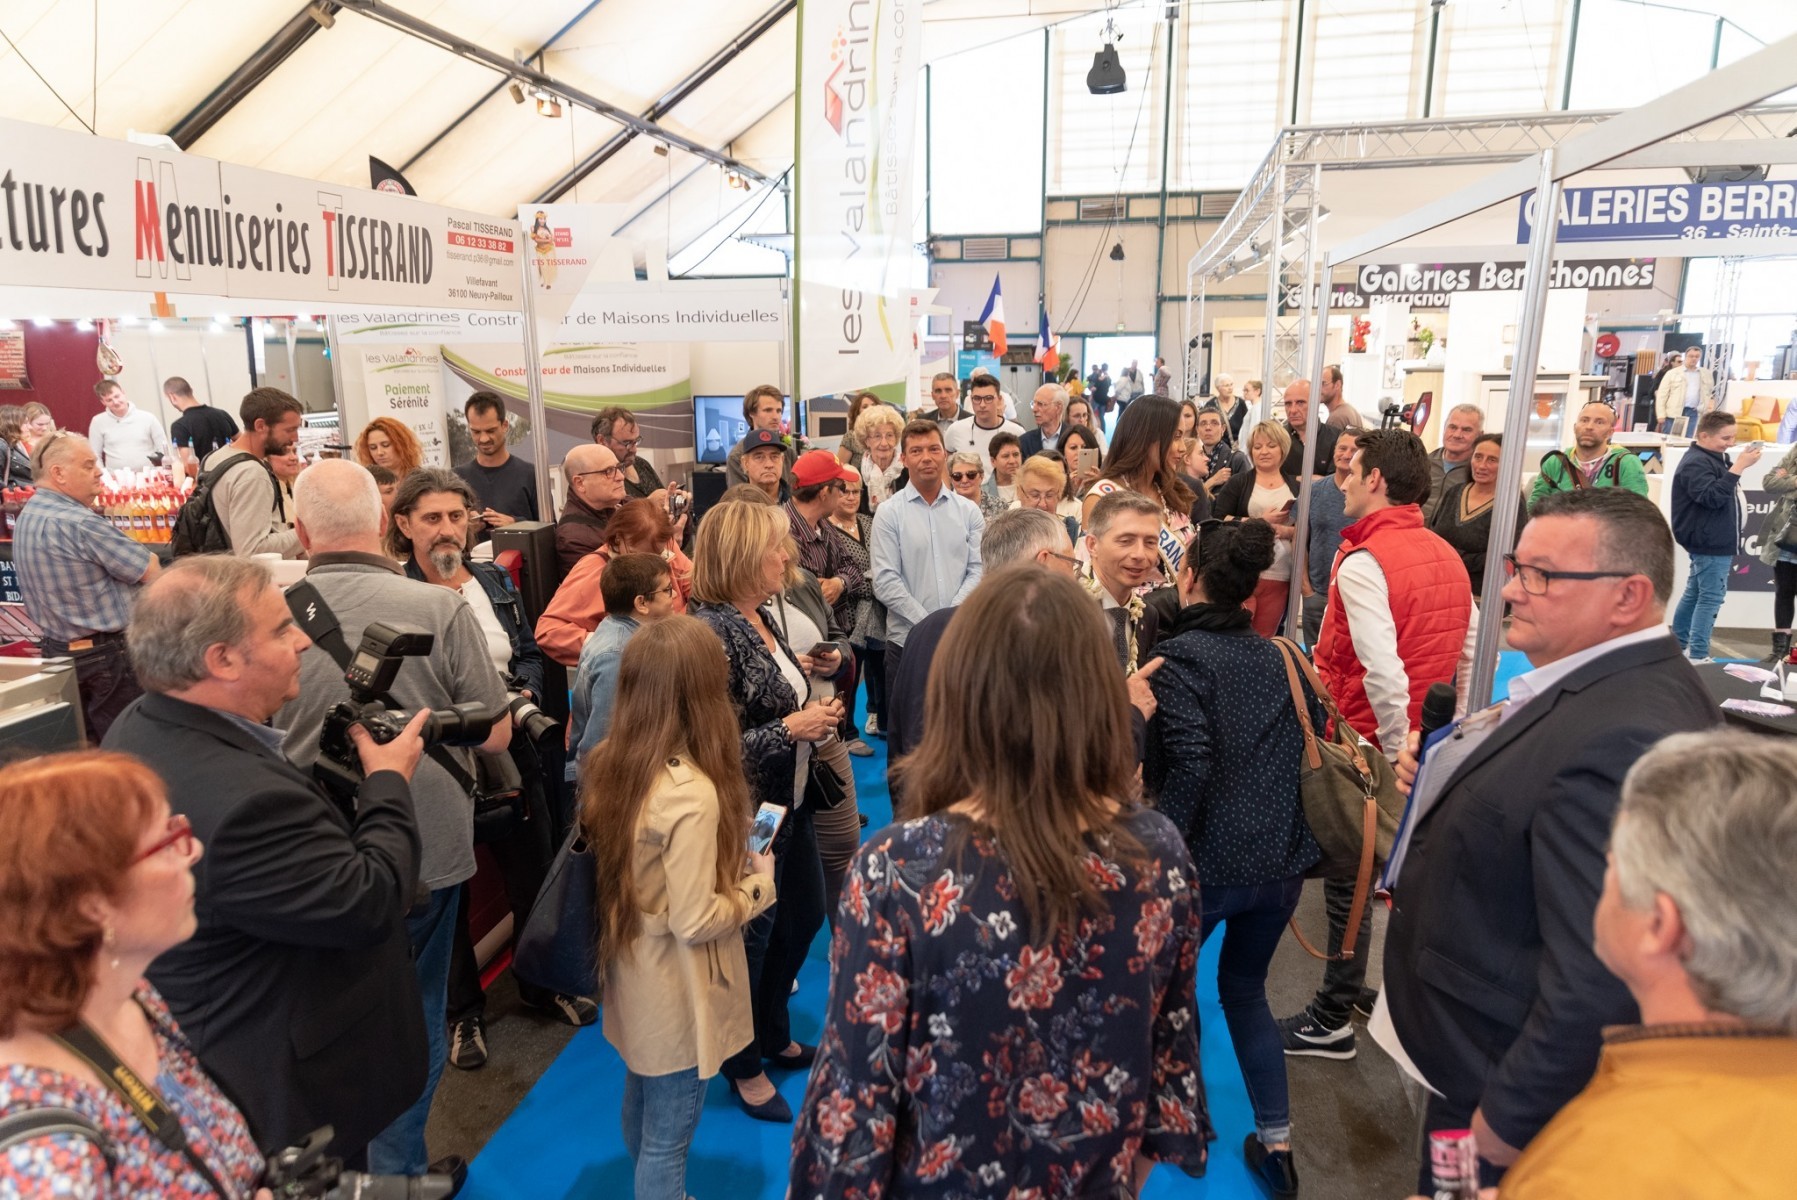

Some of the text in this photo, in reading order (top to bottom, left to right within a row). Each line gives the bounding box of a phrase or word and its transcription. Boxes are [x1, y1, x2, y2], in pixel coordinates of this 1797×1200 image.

[1699, 184, 1797, 221] BERR
[0, 169, 433, 285] tures Menuiseries TISSERAND
[447, 217, 513, 238] Pascal TISSERAND
[1680, 225, 1708, 240] 36
[455, 234, 507, 251] 06 12 33 38 82
[546, 258, 587, 266] TISSERAND
[466, 276, 498, 287] Villefavant
[1360, 260, 1654, 292] Galeries Berhonnes
[448, 288, 513, 301] 36100 Neuvy-Pailloux
[337, 313, 360, 323] les
[363, 311, 461, 324] Valandrines
[576, 312, 596, 325] de
[603, 312, 670, 325] Maisons
[676, 309, 779, 325] Individuelles
[838, 287, 863, 355] les
[365, 353, 439, 363] les Valandrines
[560, 364, 571, 375] de
[573, 363, 610, 374] Maisons
[612, 362, 666, 373] Individuelles
[385, 383, 431, 396] Paiement
[390, 397, 429, 409] Sérénité
